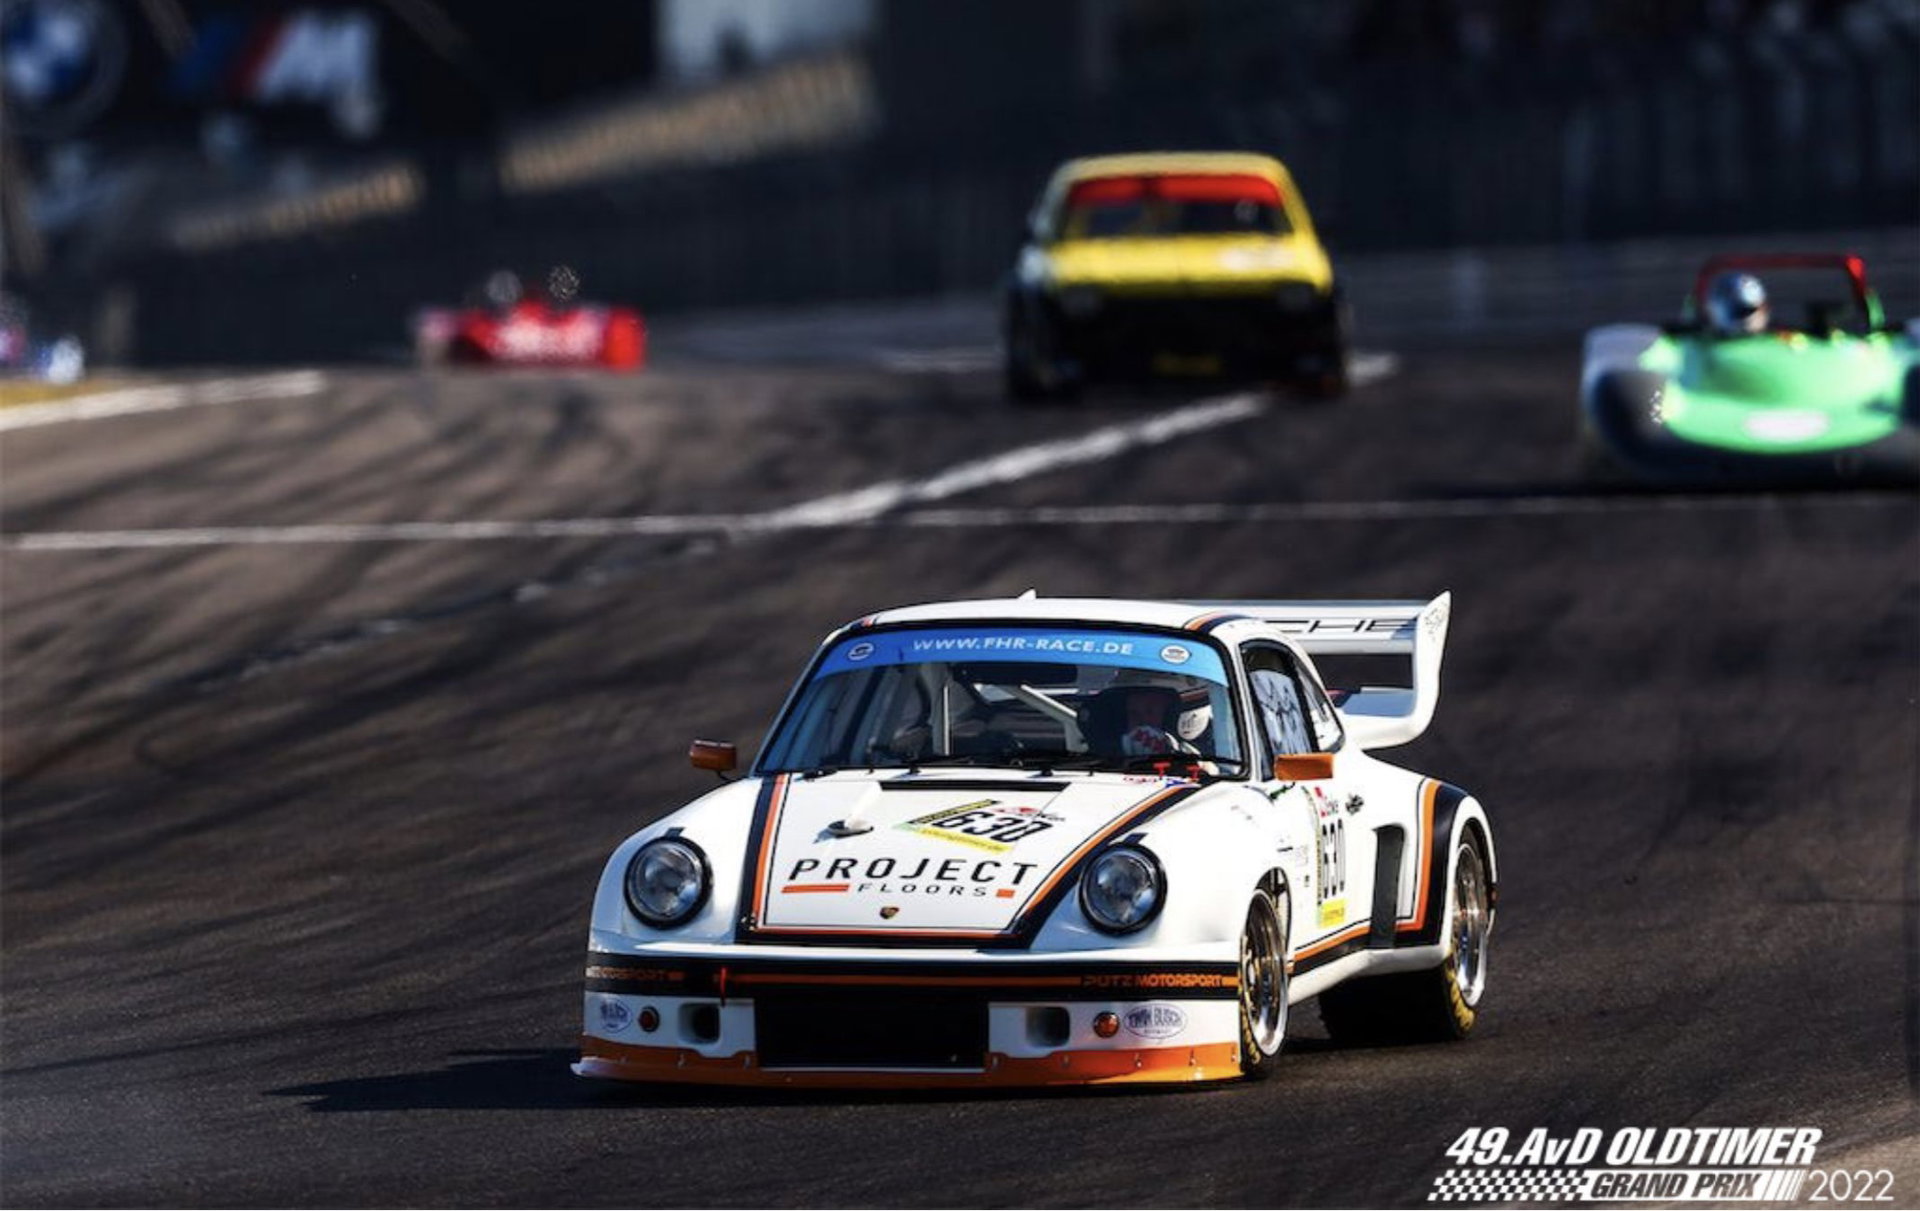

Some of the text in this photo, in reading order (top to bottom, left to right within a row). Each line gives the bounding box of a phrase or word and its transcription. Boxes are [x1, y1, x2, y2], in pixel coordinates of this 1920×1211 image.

[913, 637, 1134, 656] WWW.FHR-RACE.DE
[931, 811, 1053, 842] 630
[788, 858, 1038, 885] PROJECT
[857, 882, 987, 898] FLOORS
[1136, 974, 1222, 987] MOTORSPORT
